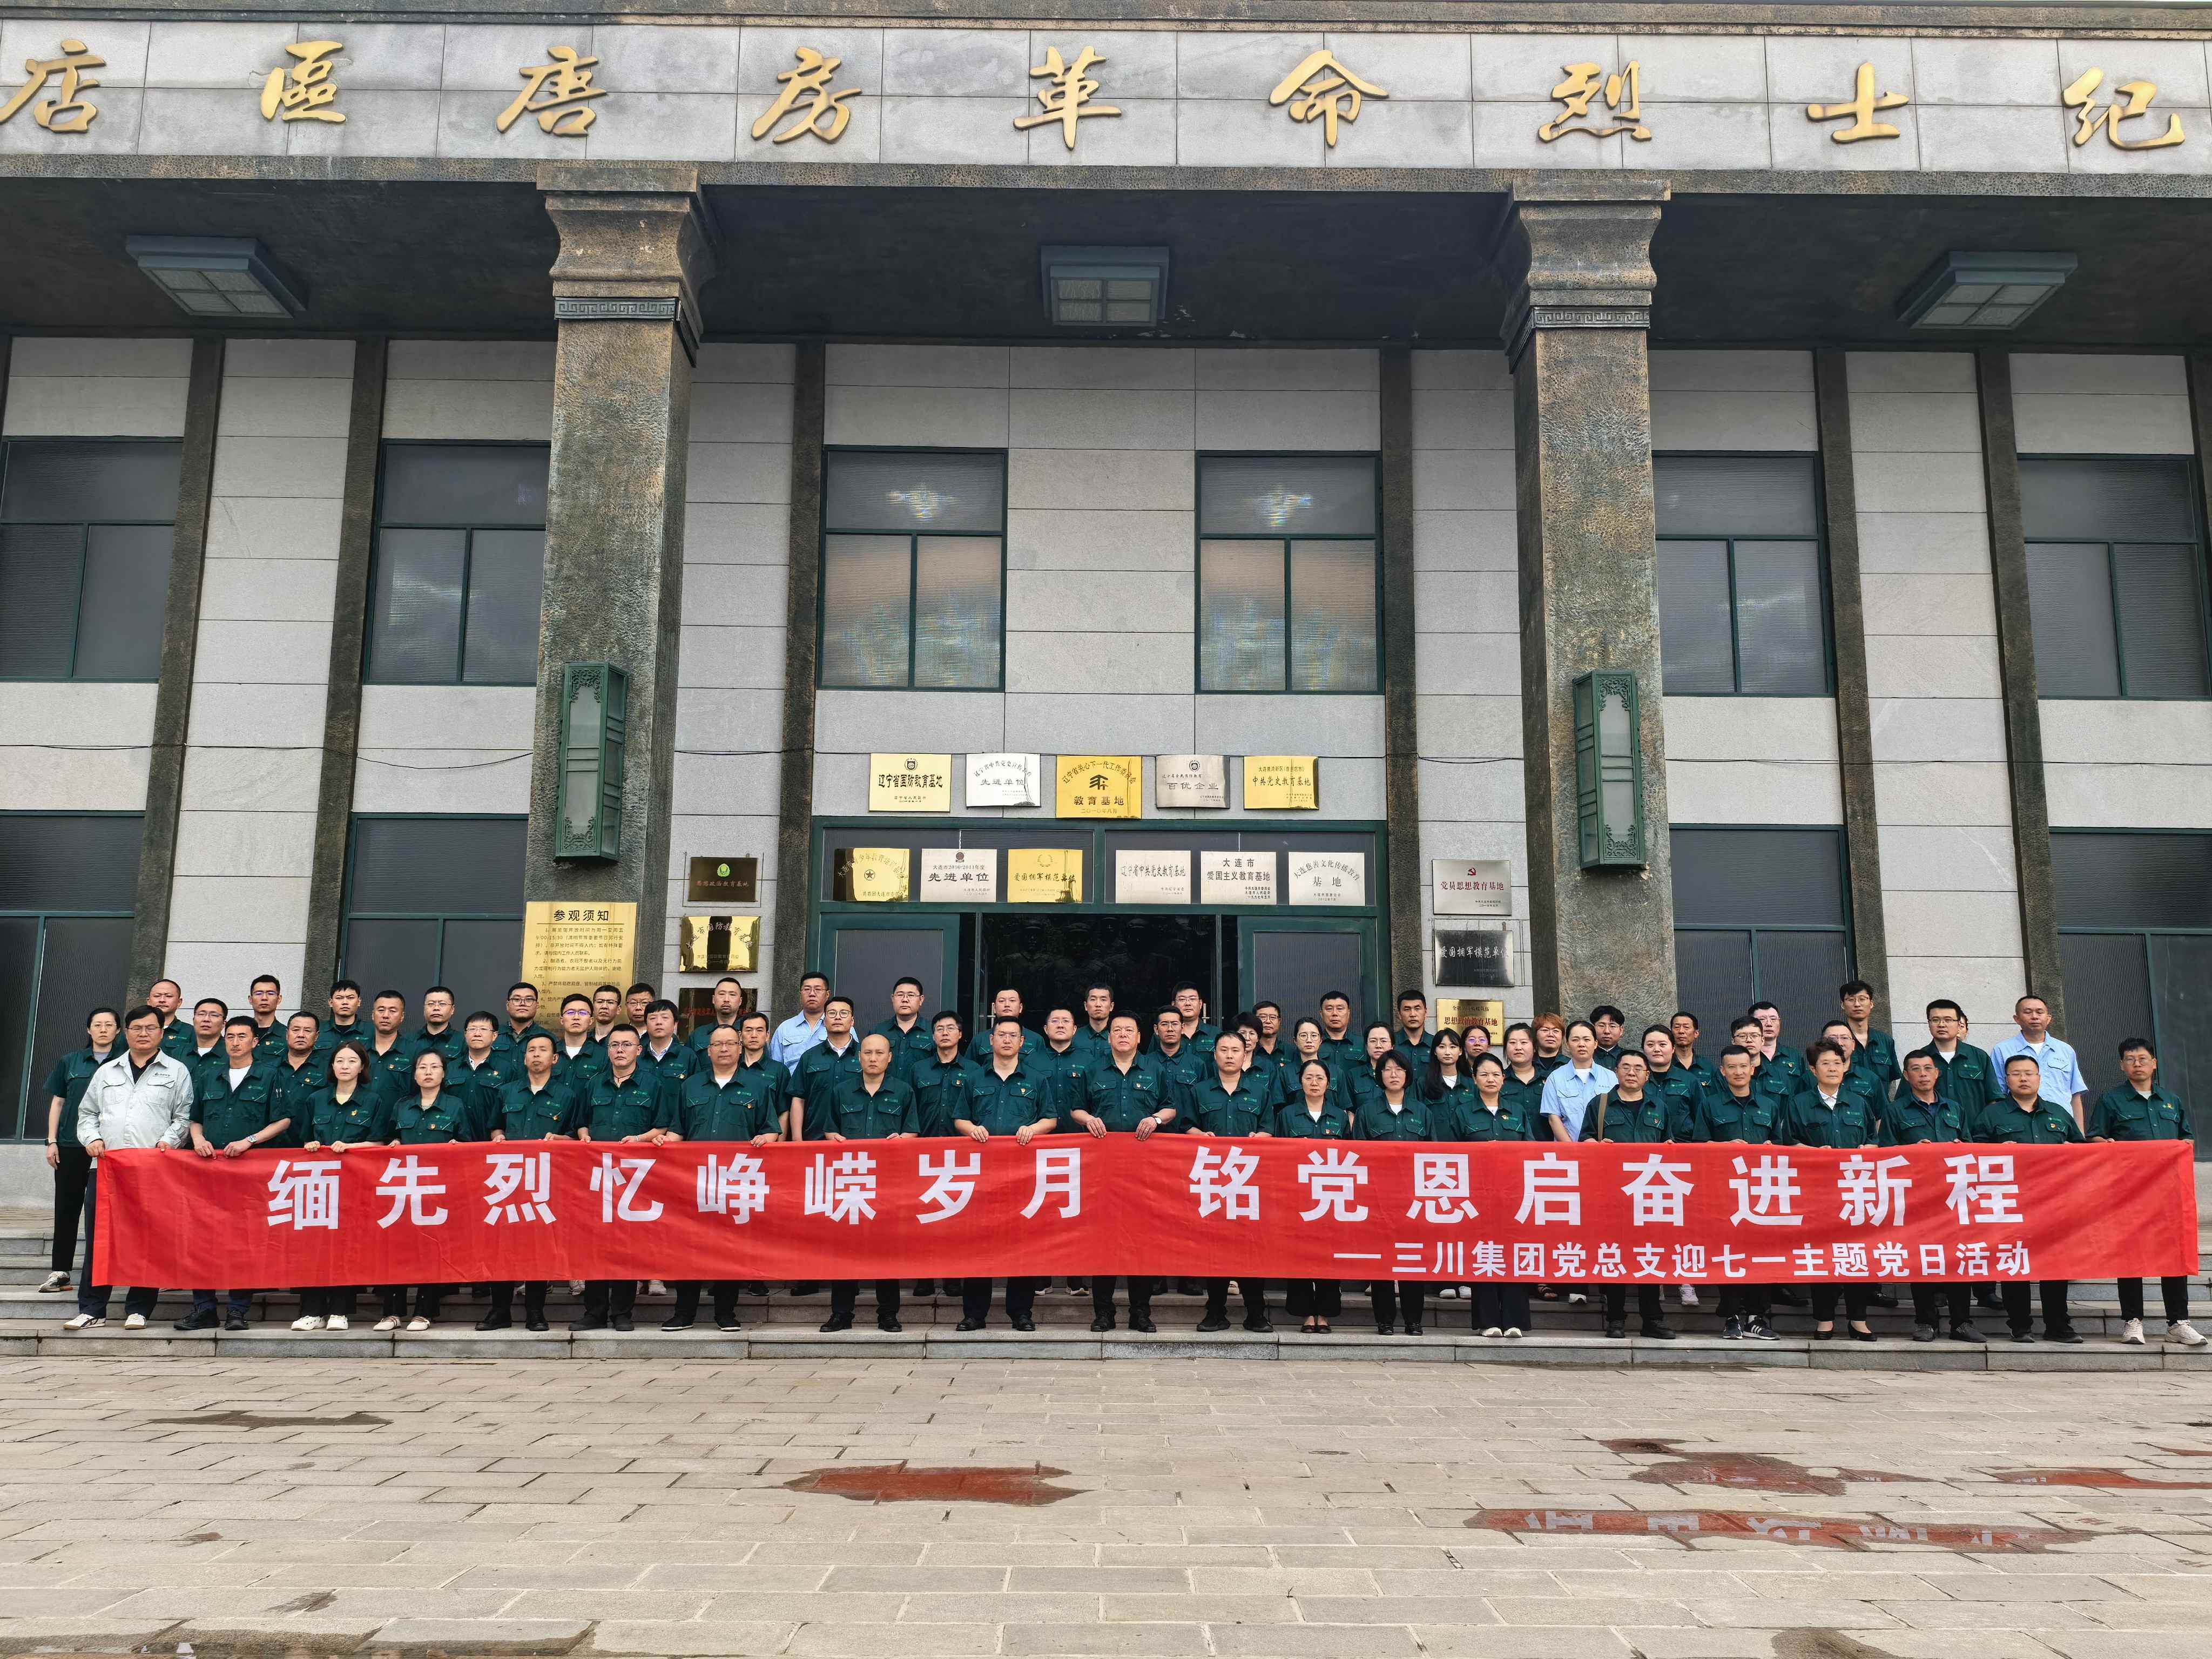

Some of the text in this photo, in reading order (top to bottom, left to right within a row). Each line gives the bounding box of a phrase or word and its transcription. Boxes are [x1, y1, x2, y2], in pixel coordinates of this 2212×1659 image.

[878, 773, 943, 788] 辽宁省国防教育基地
[1252, 775, 1311, 786] 中共党史教育基地
[1166, 782, 1219, 790] 百优企业
[1074, 795, 1124, 805] 教育基地
[1223, 858, 1255, 867] 大连市
[1121, 864, 1186, 878] 辽宁省中共党史教育基地
[1206, 871, 1270, 881] 爱国主义教育基地
[928, 872, 989, 882] 先进单位
[1313, 876, 1341, 886] 基地
[1440, 881, 1504, 891] 党员思想教育基地
[554, 909, 609, 921] 参观须知
[267, 1145, 2024, 1231] 缅先烈忆峥嵘岁月 铭党恩启奋进新程
